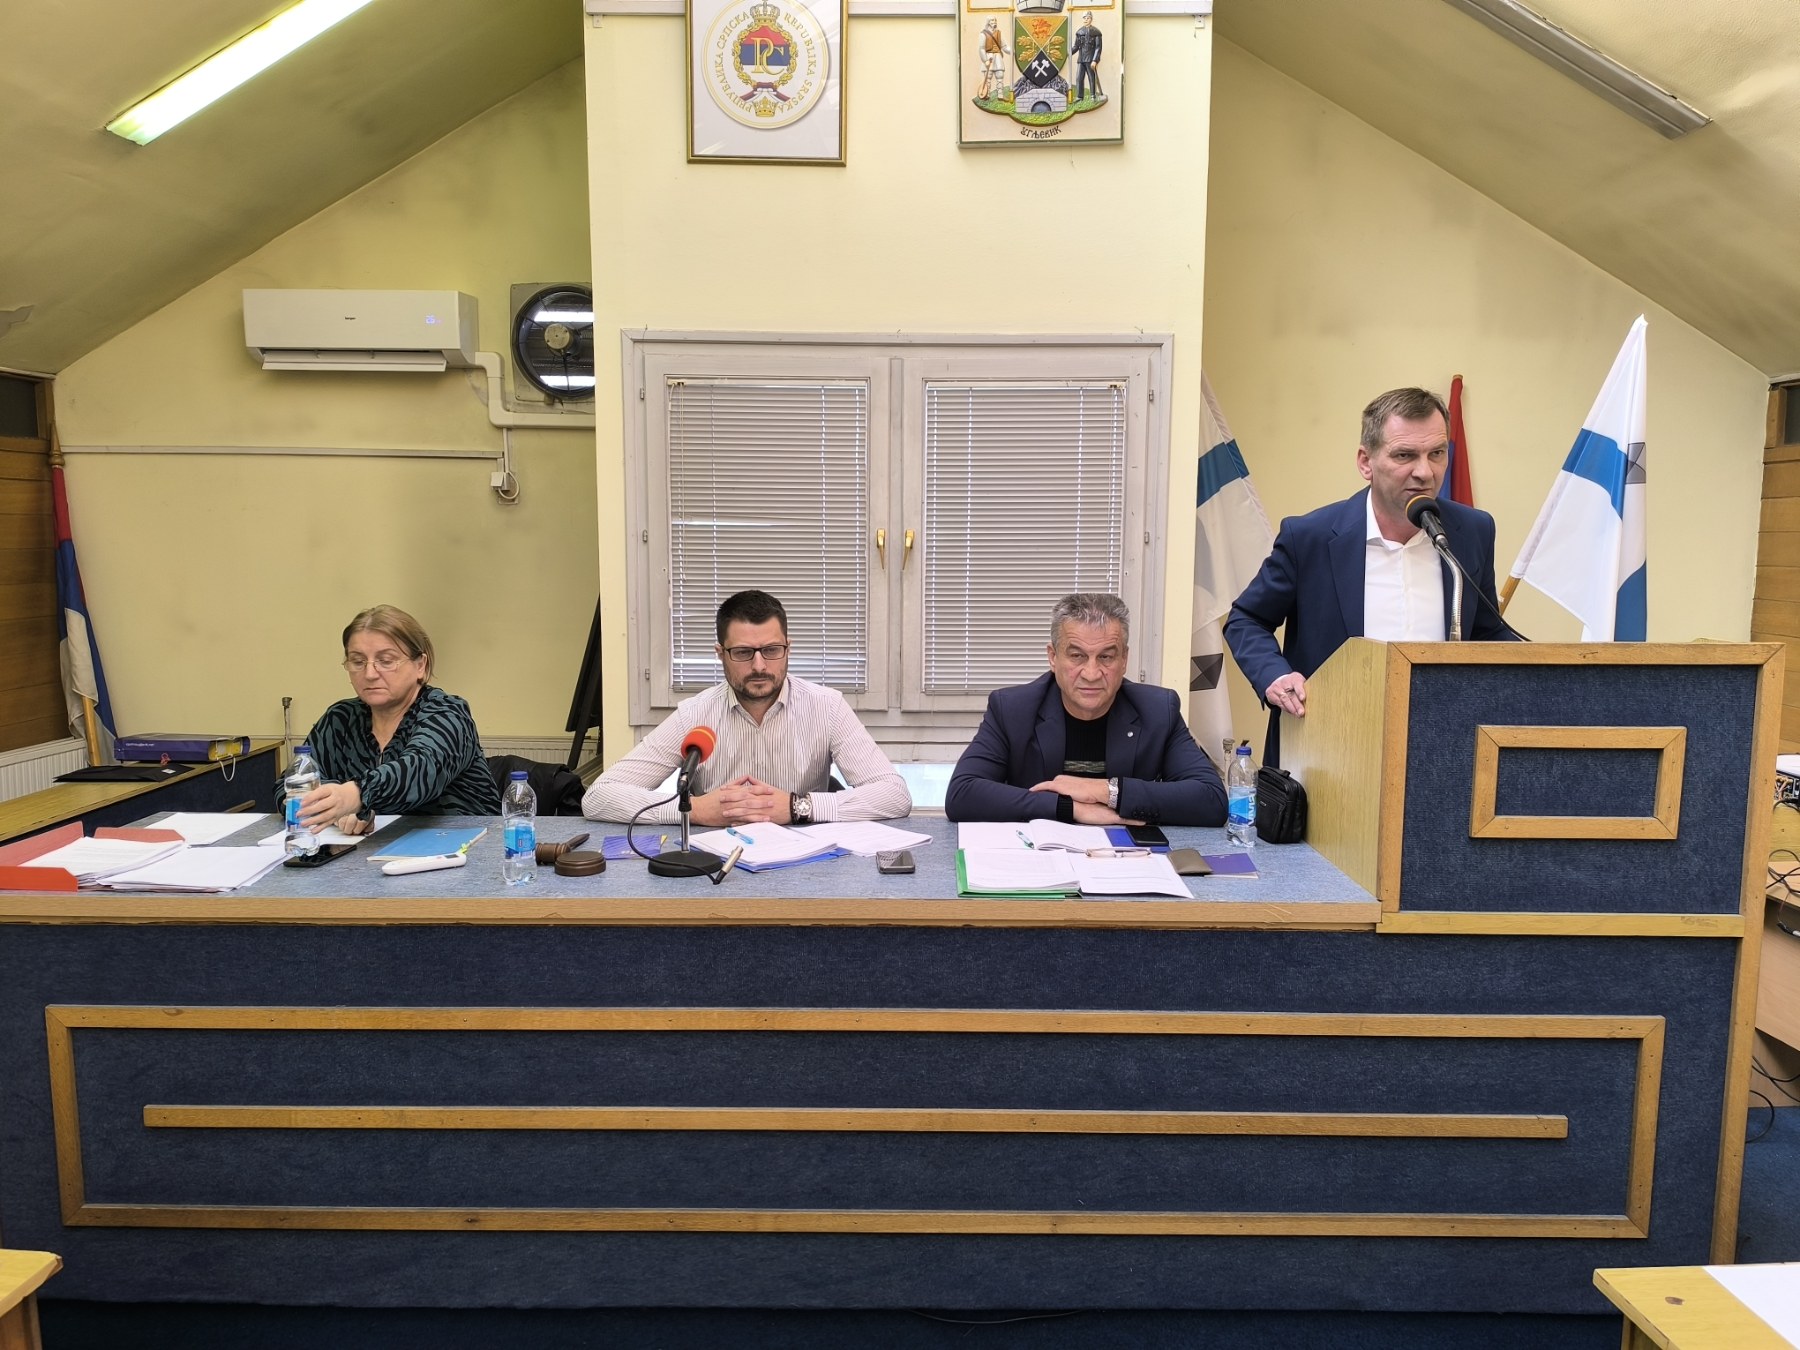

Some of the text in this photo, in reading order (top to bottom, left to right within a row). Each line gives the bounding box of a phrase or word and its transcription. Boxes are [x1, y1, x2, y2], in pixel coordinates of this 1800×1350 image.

[715, 11, 753, 113] РЕПУБЛИКА СРПСКА
[777, 12, 817, 114] REPUBLIKA SRPSKA
